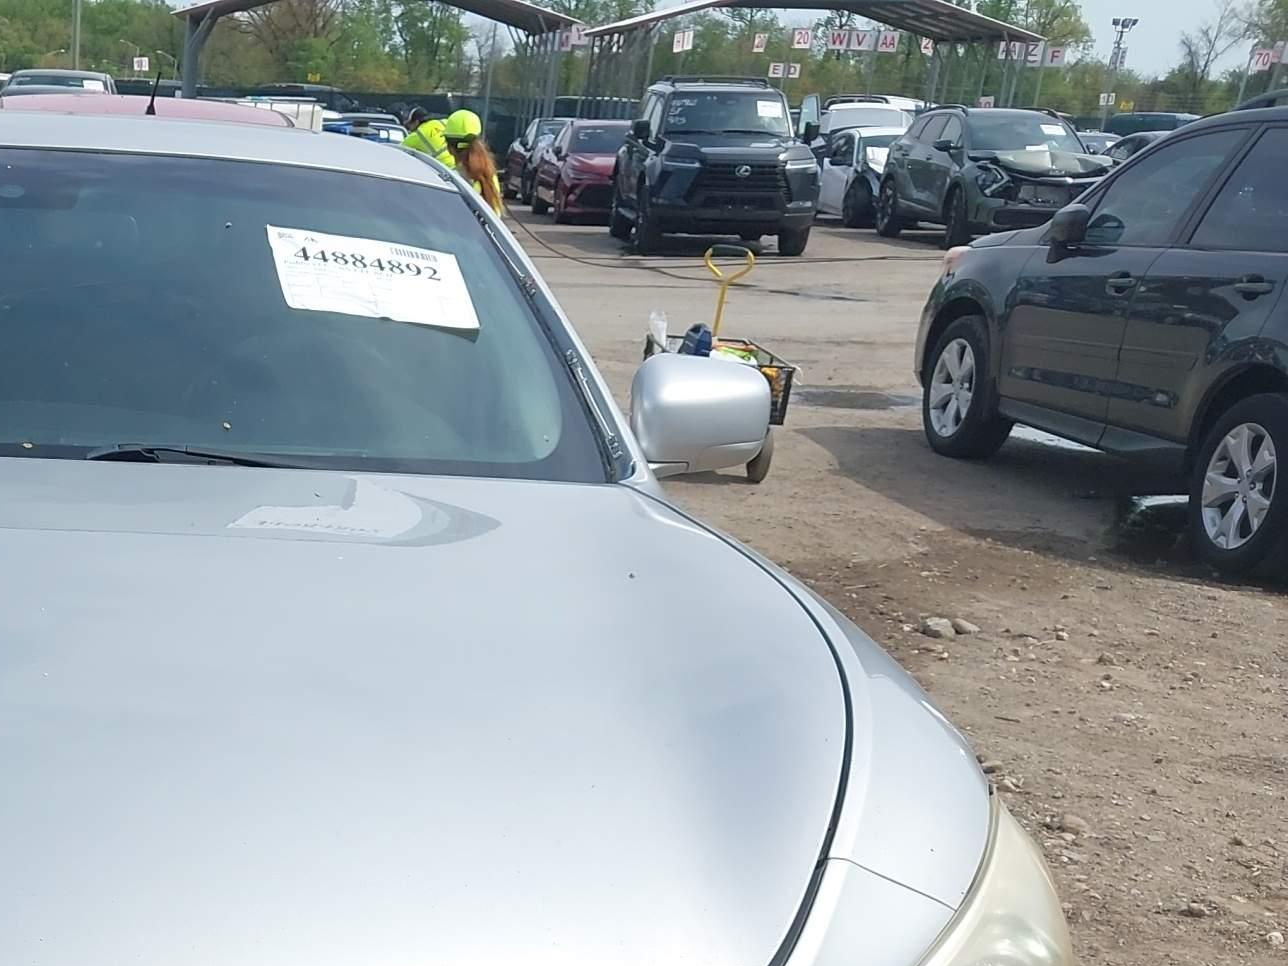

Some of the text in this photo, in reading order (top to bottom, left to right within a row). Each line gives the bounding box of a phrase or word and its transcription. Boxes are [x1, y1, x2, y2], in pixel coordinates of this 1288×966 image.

[796, 31, 810, 45] 20
[831, 32, 847, 46] W
[855, 33, 867, 47] V
[880, 34, 896, 48] AA
[1050, 50, 1061, 64] F
[1255, 52, 1270, 66] 70
[772, 64, 782, 75] E
[294, 246, 442, 282] 44884892
